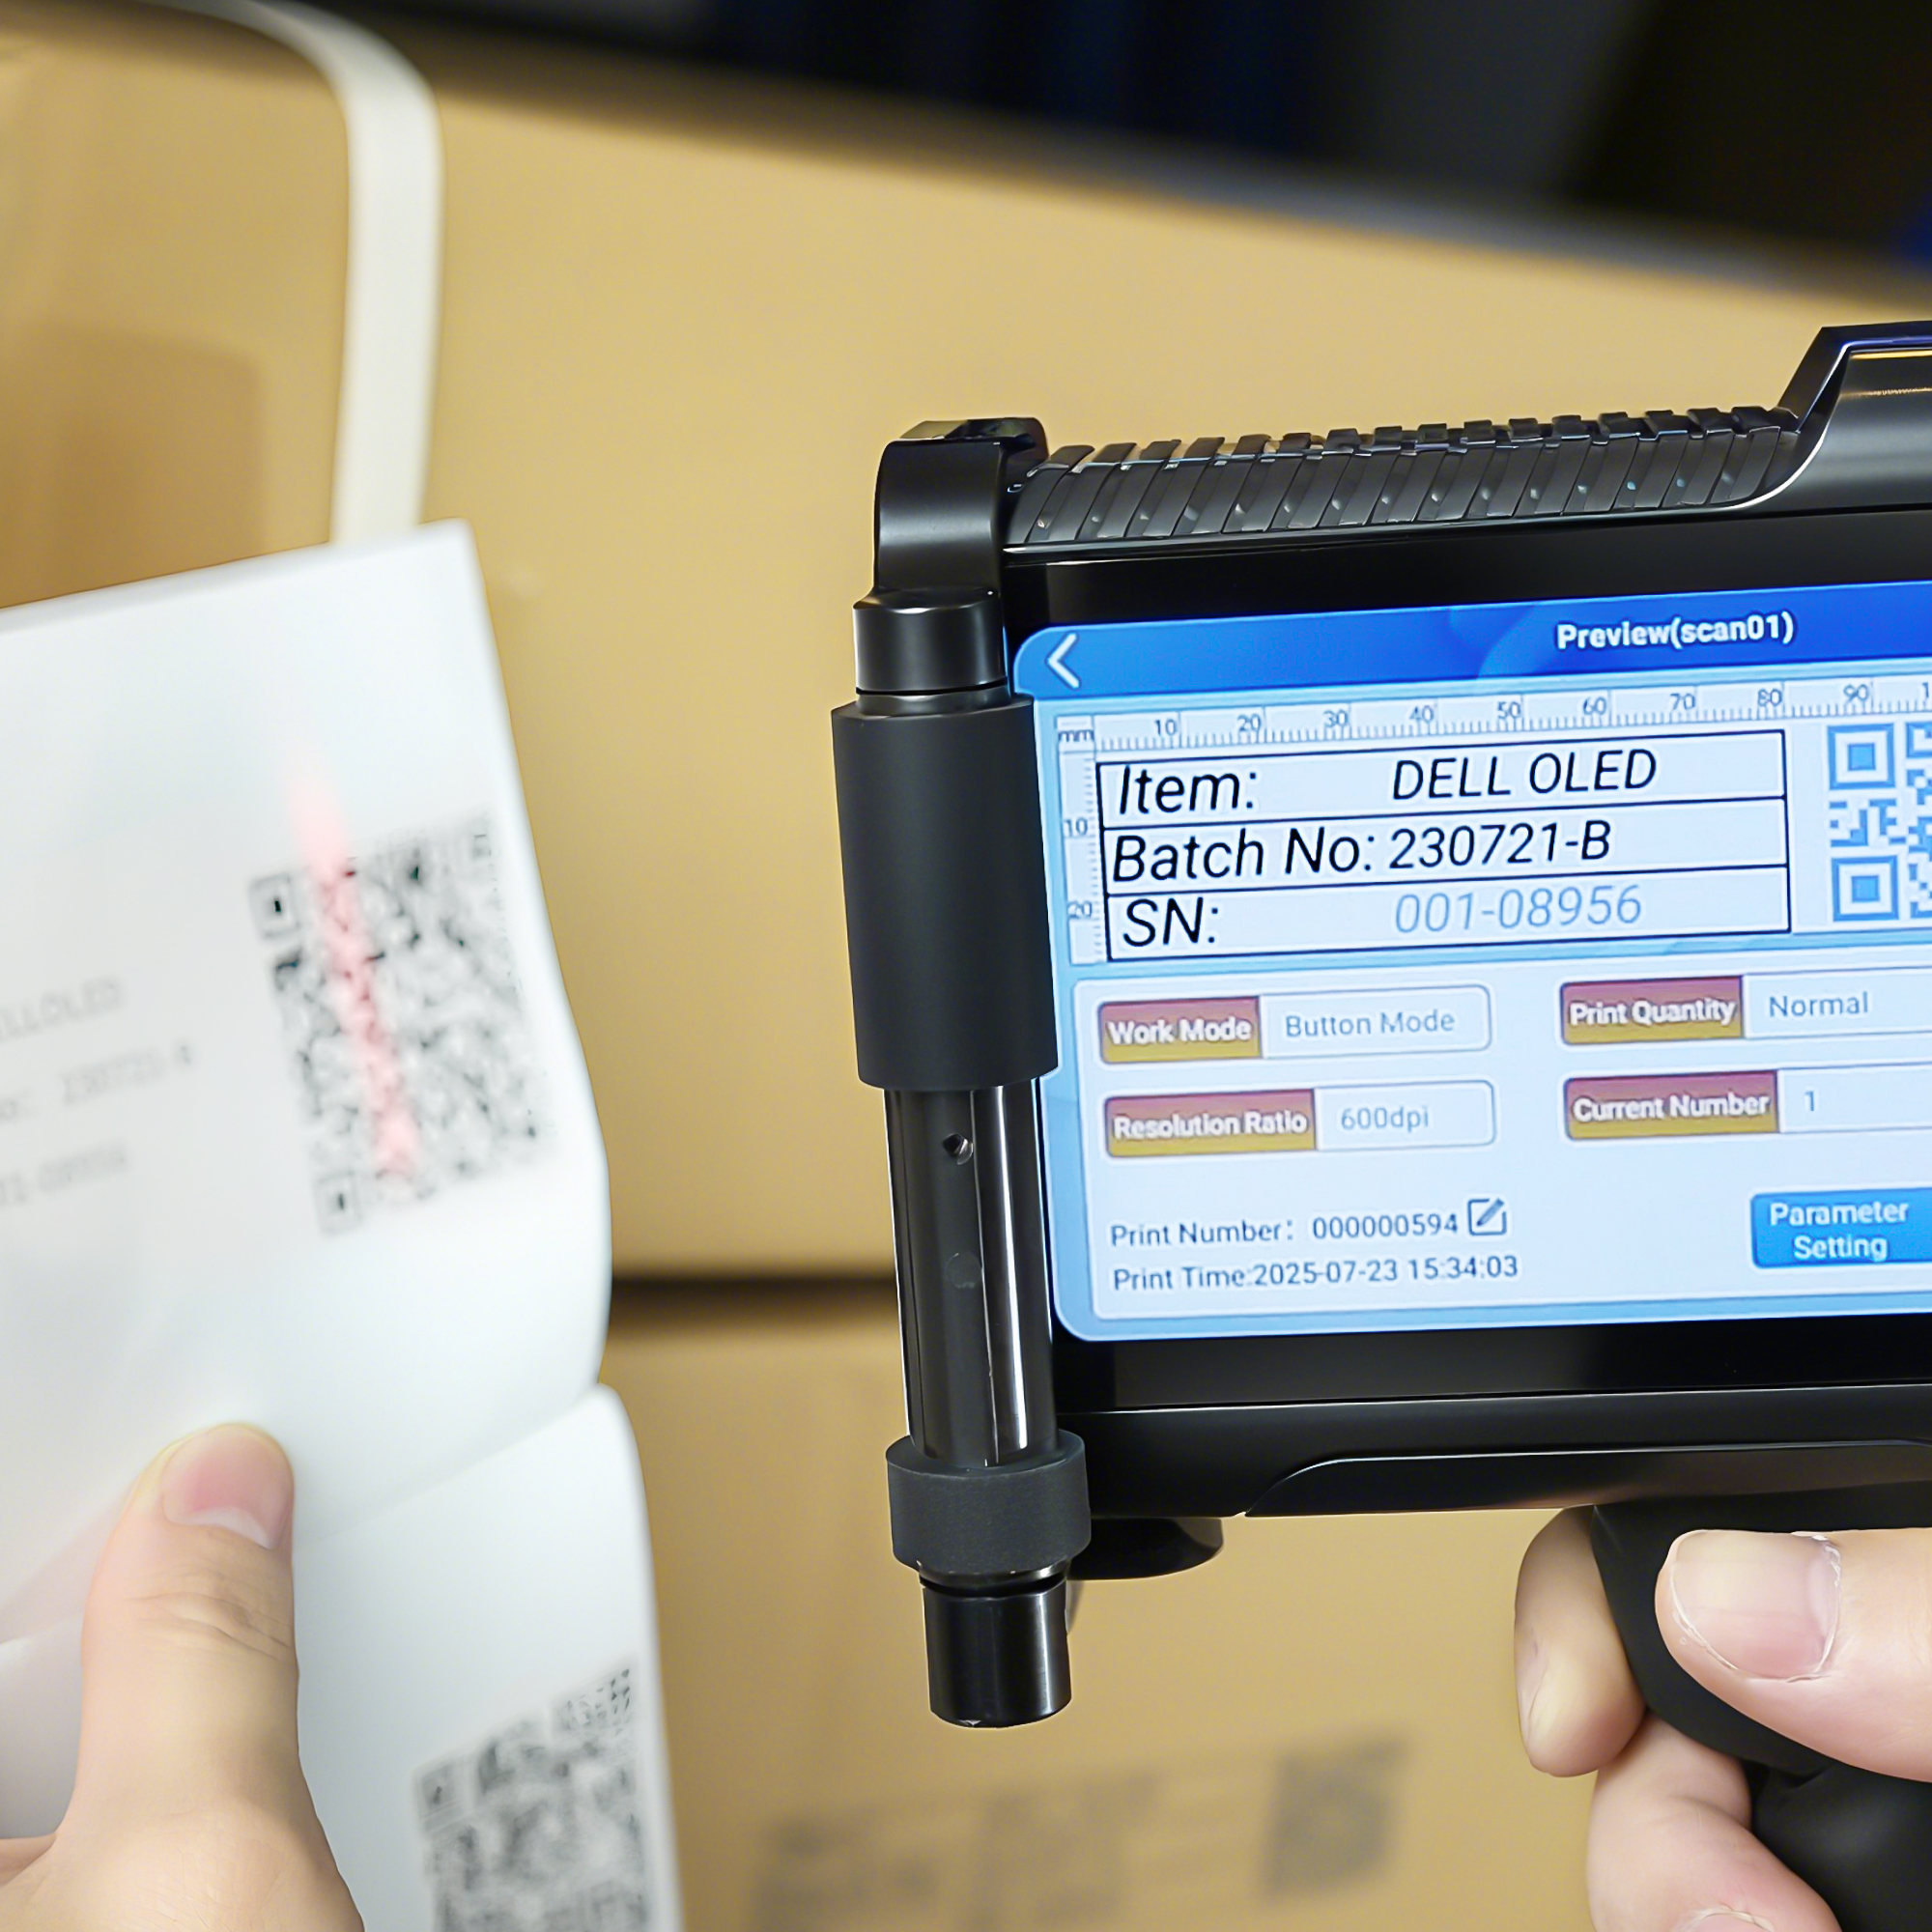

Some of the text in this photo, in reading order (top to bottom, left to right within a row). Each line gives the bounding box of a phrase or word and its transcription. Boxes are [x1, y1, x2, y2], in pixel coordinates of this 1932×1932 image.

[1556, 611, 1795, 650] Preview(scan01)
[1154, 718, 1178, 737] 10
[1236, 714, 1261, 733] 20
[1322, 709, 1349, 728] 30
[1408, 705, 1435, 724] 40
[1498, 701, 1521, 720] 50
[1582, 696, 1606, 716] 60
[1670, 693, 1695, 711] 70
[1757, 688, 1782, 707] 80
[1843, 683, 1869, 705] 90
[1119, 749, 1657, 814] Item: DELL OLED
[1065, 817, 1089, 837] 10
[1113, 819, 1611, 882] Batch No: 230721-B
[1122, 884, 1641, 947] SN: 001-08956
[1107, 1009, 1455, 1045] Work Mode Button Mode
[1569, 991, 1868, 1027] Print Quantity Normal
[1113, 1105, 1430, 1140] Resolution Ratio 600dpi
[1573, 1091, 1816, 1122] Current Number 1
[1111, 1212, 1458, 1247] Print Number: 000000594
[1770, 1201, 1909, 1227] Parameter
[1794, 1235, 1888, 1263] Setting
[1114, 1268, 1174, 1291] Print
[1408, 1254, 1519, 1280] 15:34:03
